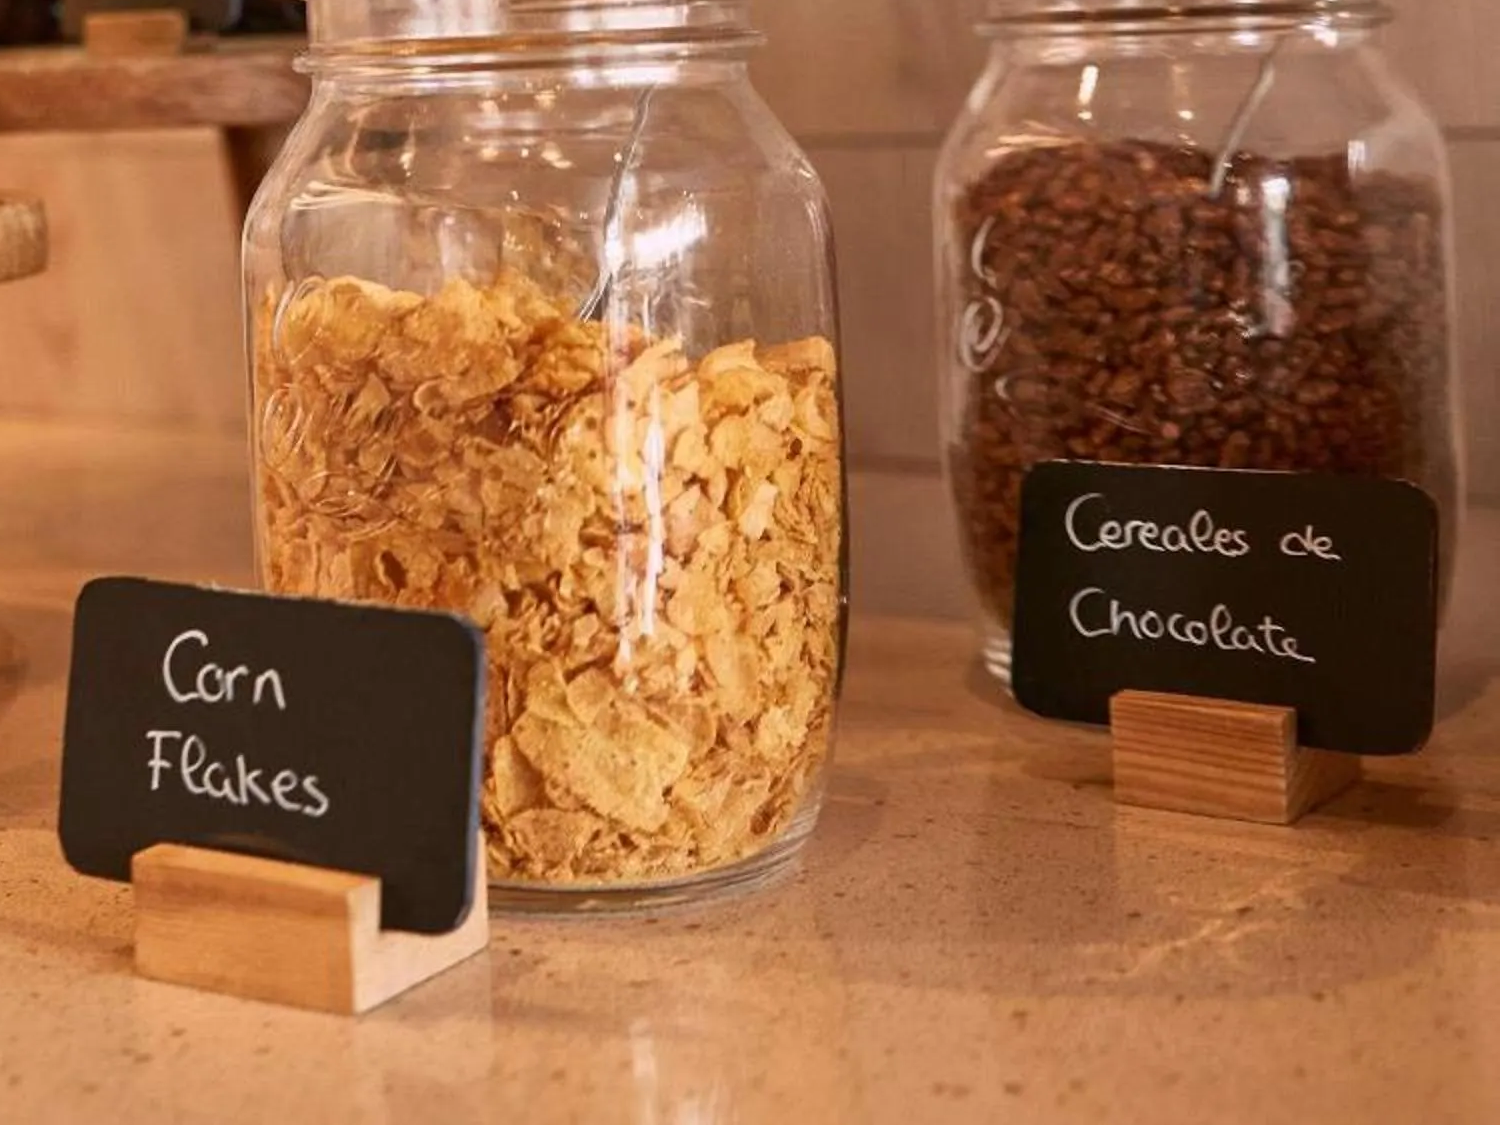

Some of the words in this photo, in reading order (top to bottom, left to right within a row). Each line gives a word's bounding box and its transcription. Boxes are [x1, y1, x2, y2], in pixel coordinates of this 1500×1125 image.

[1065, 492, 1250, 558] Cereales
[1280, 524, 1342, 561] de
[1069, 587, 1317, 663] Chocolate
[162, 629, 286, 710] Corn
[145, 730, 330, 817] Flakes
